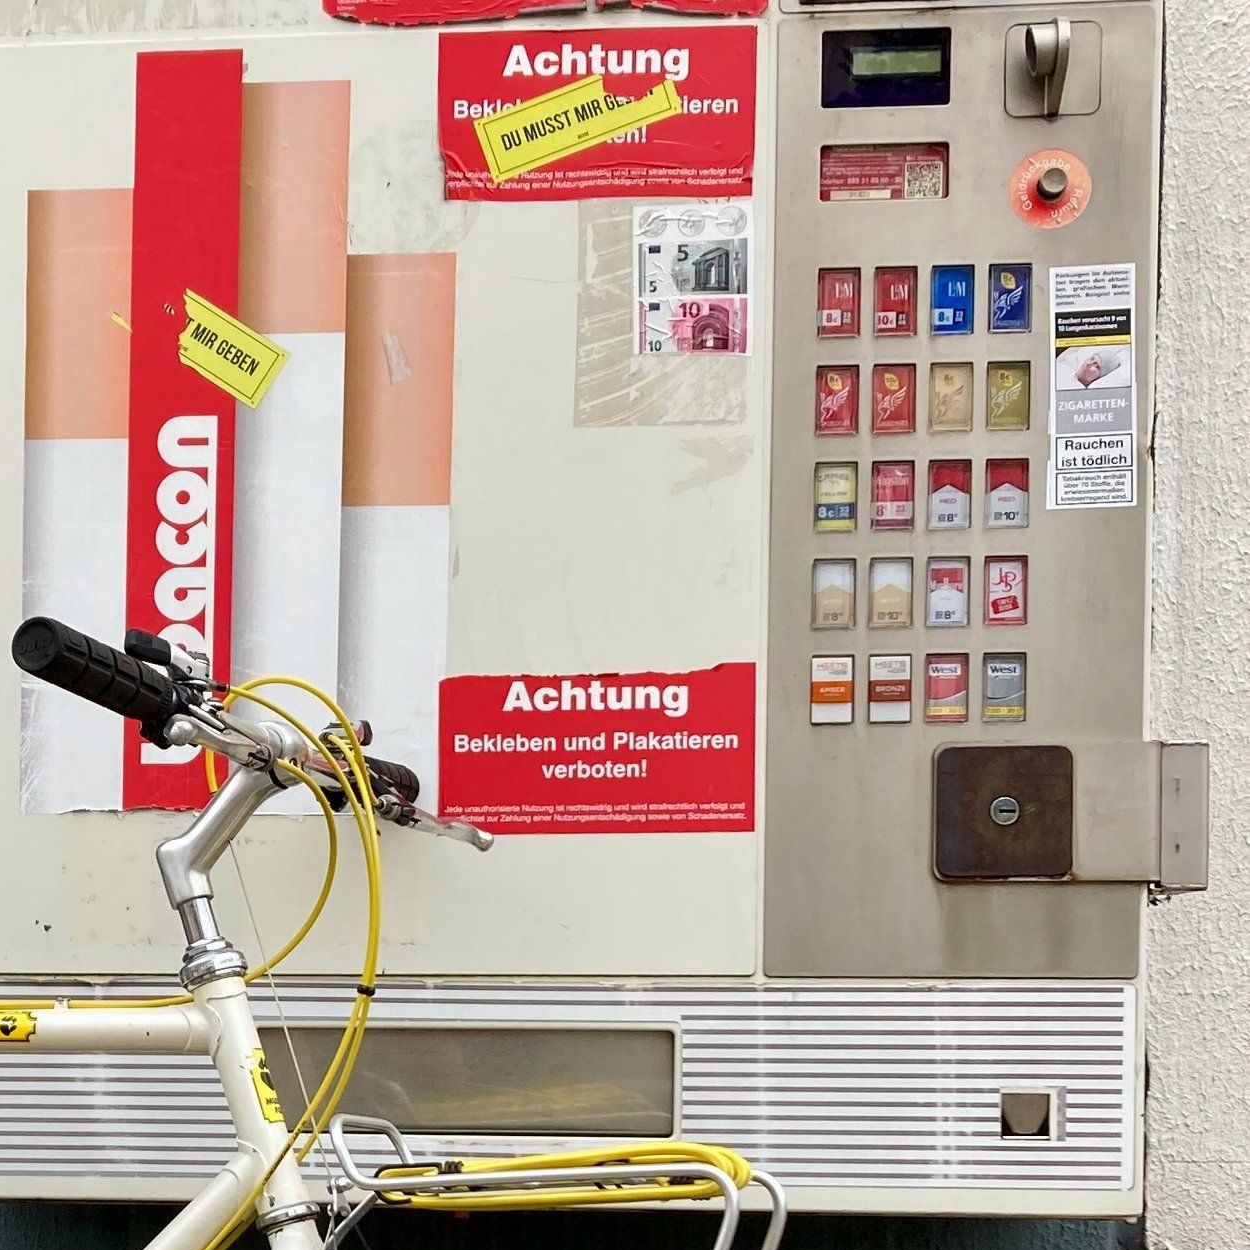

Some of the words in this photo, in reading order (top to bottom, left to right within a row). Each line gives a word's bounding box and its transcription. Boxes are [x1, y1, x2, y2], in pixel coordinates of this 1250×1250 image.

[502, 44, 690, 81] Achtung
[453, 98, 522, 119] Bekle
[500, 129, 521, 151] DU
[523, 109, 572, 143] MUSST
[574, 99, 603, 124] MIR
[521, 170, 553, 180] Nutzung
[499, 180, 531, 190] Zahlung
[676, 244, 689, 262] 5
[649, 281, 657, 293] 5
[678, 302, 701, 319] 10
[190, 322, 218, 351] MIR
[216, 339, 260, 377] GEBEN
[648, 340, 662, 352] 10
[1058, 397, 1129, 411] ZIGARETTEN-
[1073, 412, 1115, 424] MARKE
[1064, 438, 1124, 451] Rauchen
[1061, 456, 1077, 467] ist
[1081, 454, 1127, 467] tödlich
[931, 666, 959, 674] West
[990, 665, 1017, 674] West
[502, 680, 689, 717] Achtung
[453, 734, 557, 753] Bekleben
[563, 732, 606, 751] und
[612, 731, 739, 751] Plakatieren
[541, 758, 648, 779] verboten!
[521, 803, 554, 814] Nutzung
[500, 814, 531, 823] Zahlung
